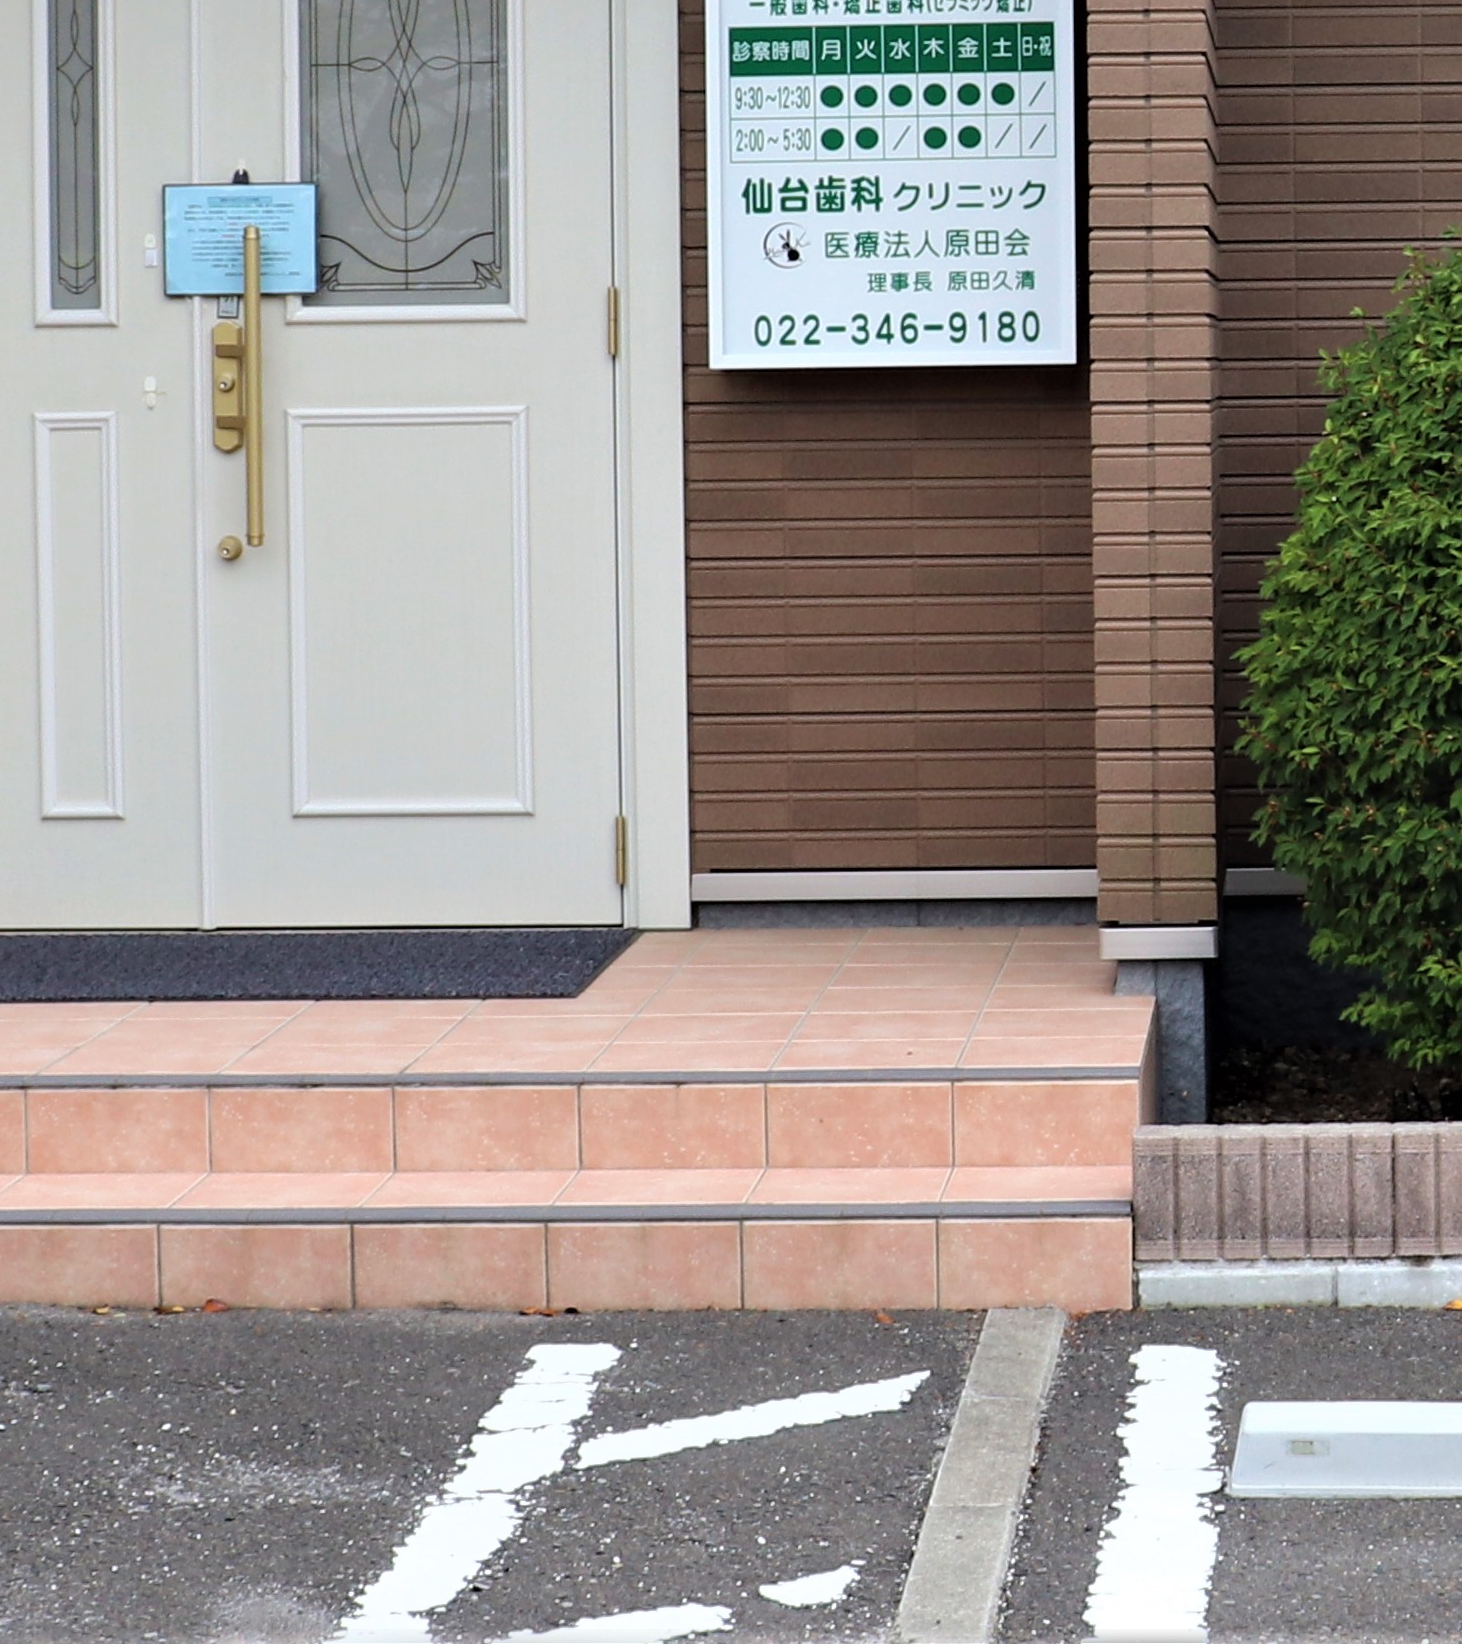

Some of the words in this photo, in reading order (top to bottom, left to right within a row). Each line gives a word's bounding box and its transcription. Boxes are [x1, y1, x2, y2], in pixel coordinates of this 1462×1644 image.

[821, 39, 841, 60] 月
[855, 38, 877, 59] 火
[889, 38, 911, 59] 水
[923, 37, 945, 58] 木
[957, 37, 979, 58] 金
[991, 37, 1013, 57] 土
[825, 228, 1030, 259] 医療法人原田会
[868, 271, 932, 293] 理事長
[754, 310, 1040, 347] 022-346-9180
